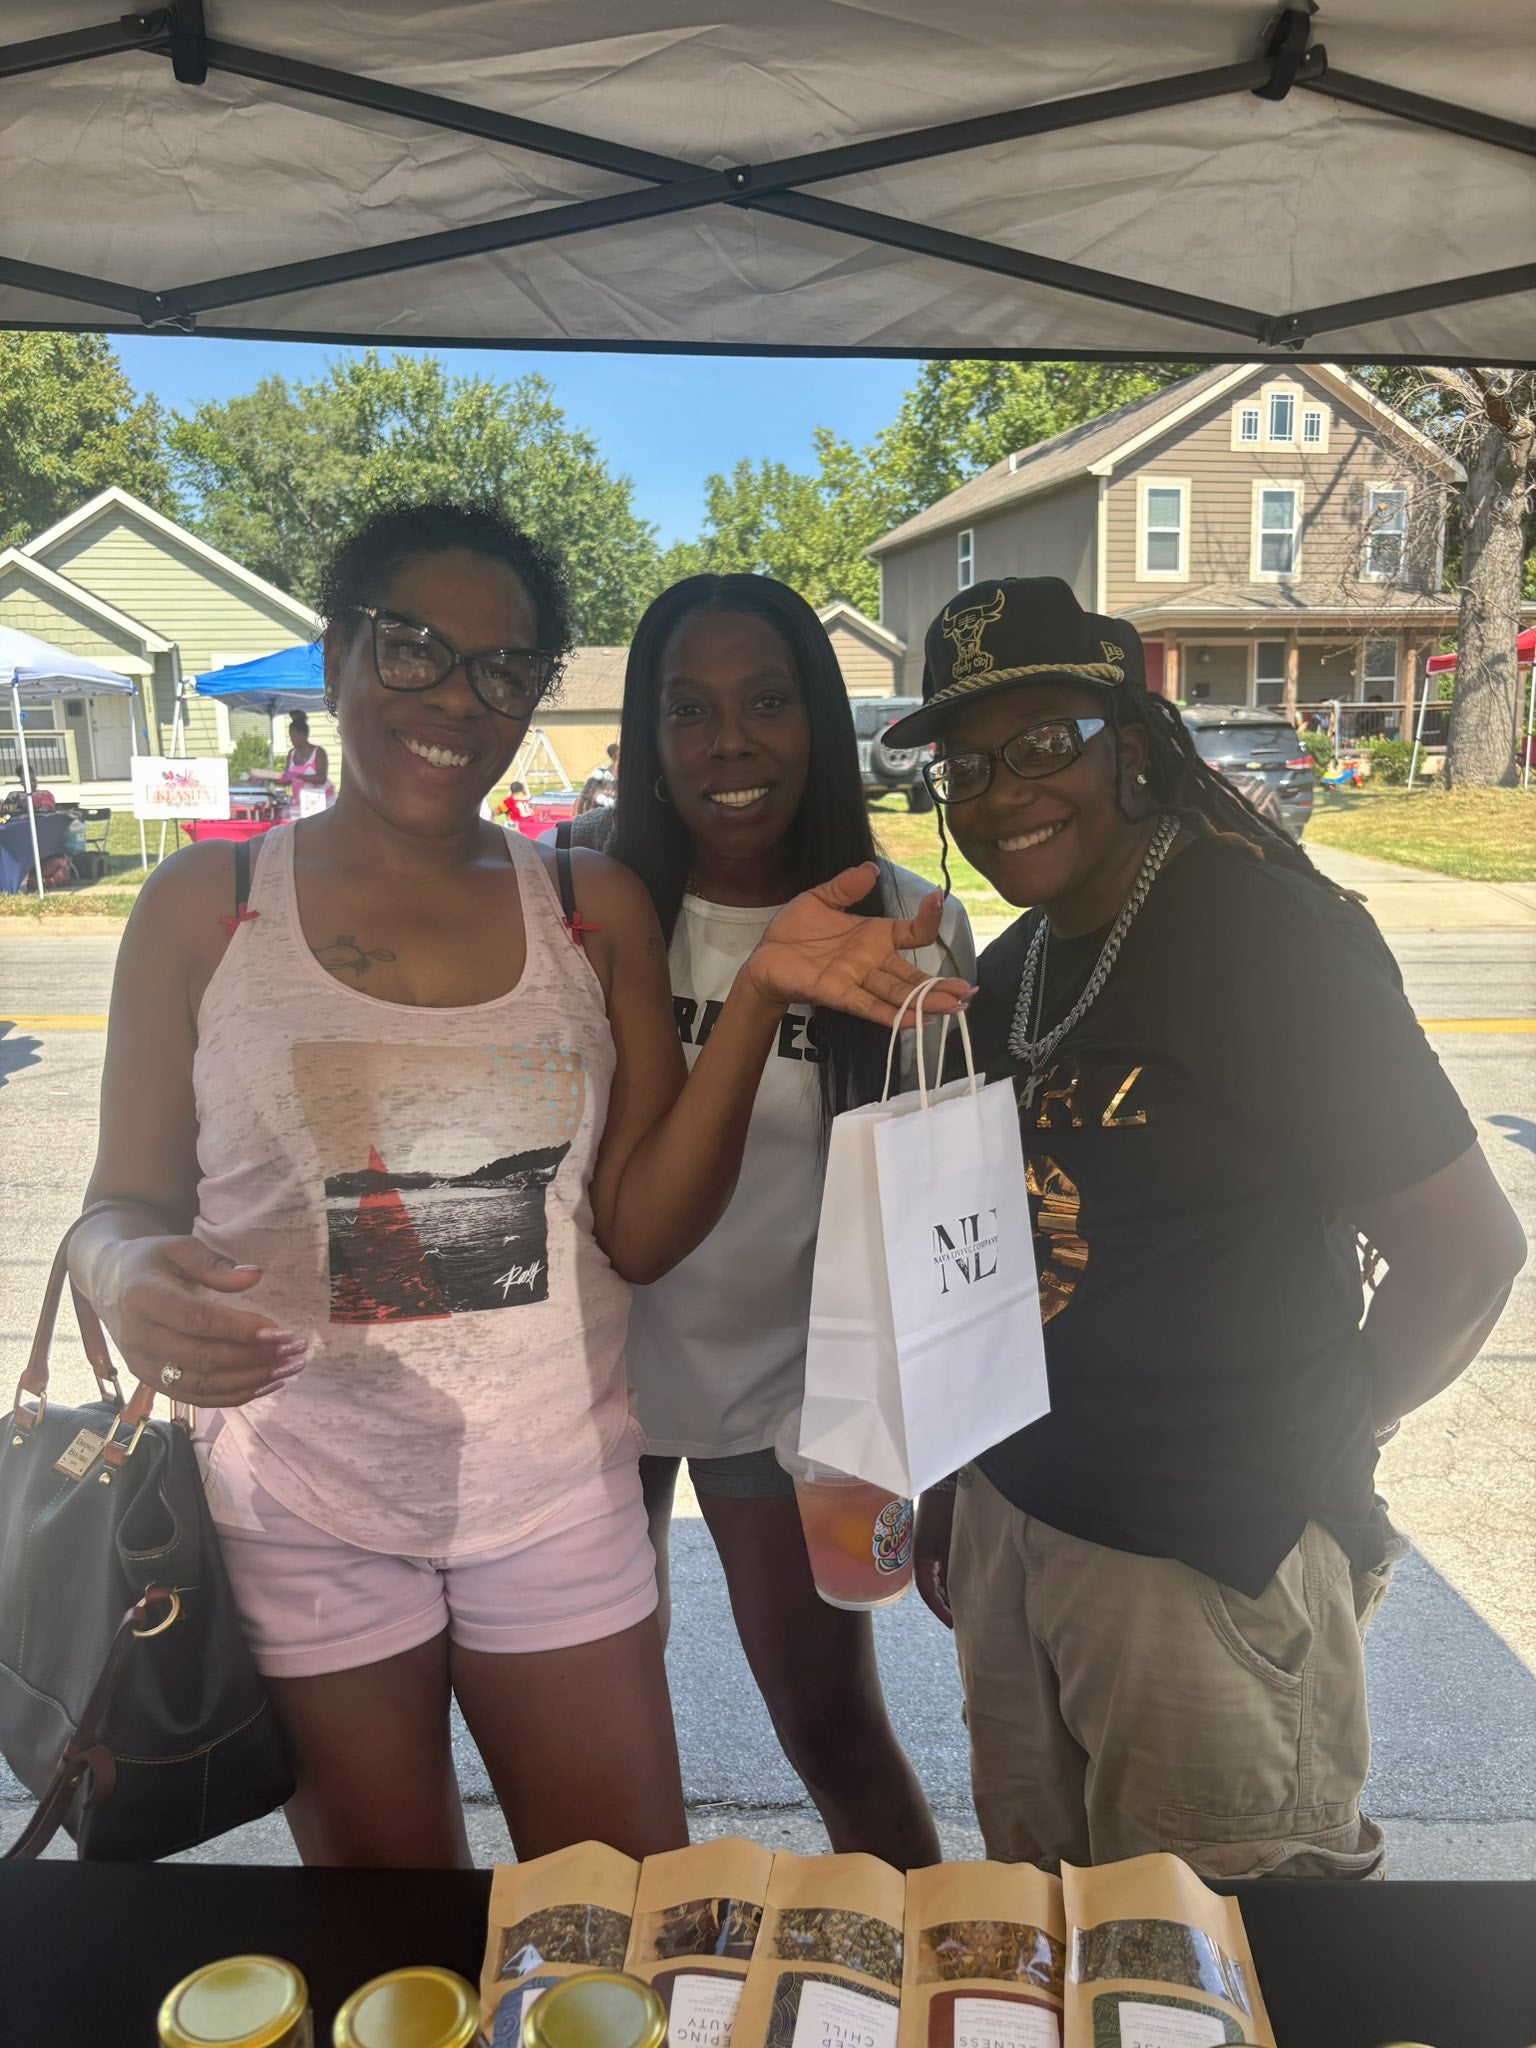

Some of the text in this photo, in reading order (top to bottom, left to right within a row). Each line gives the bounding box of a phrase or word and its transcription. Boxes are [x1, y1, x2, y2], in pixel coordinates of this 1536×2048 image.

[933, 1235, 999, 1265] NAVA LIVING COMPANY
[687, 2017, 734, 2032] AUTY
[822, 2020, 874, 2046] CHILL
[676, 2028, 731, 2047] EPING
